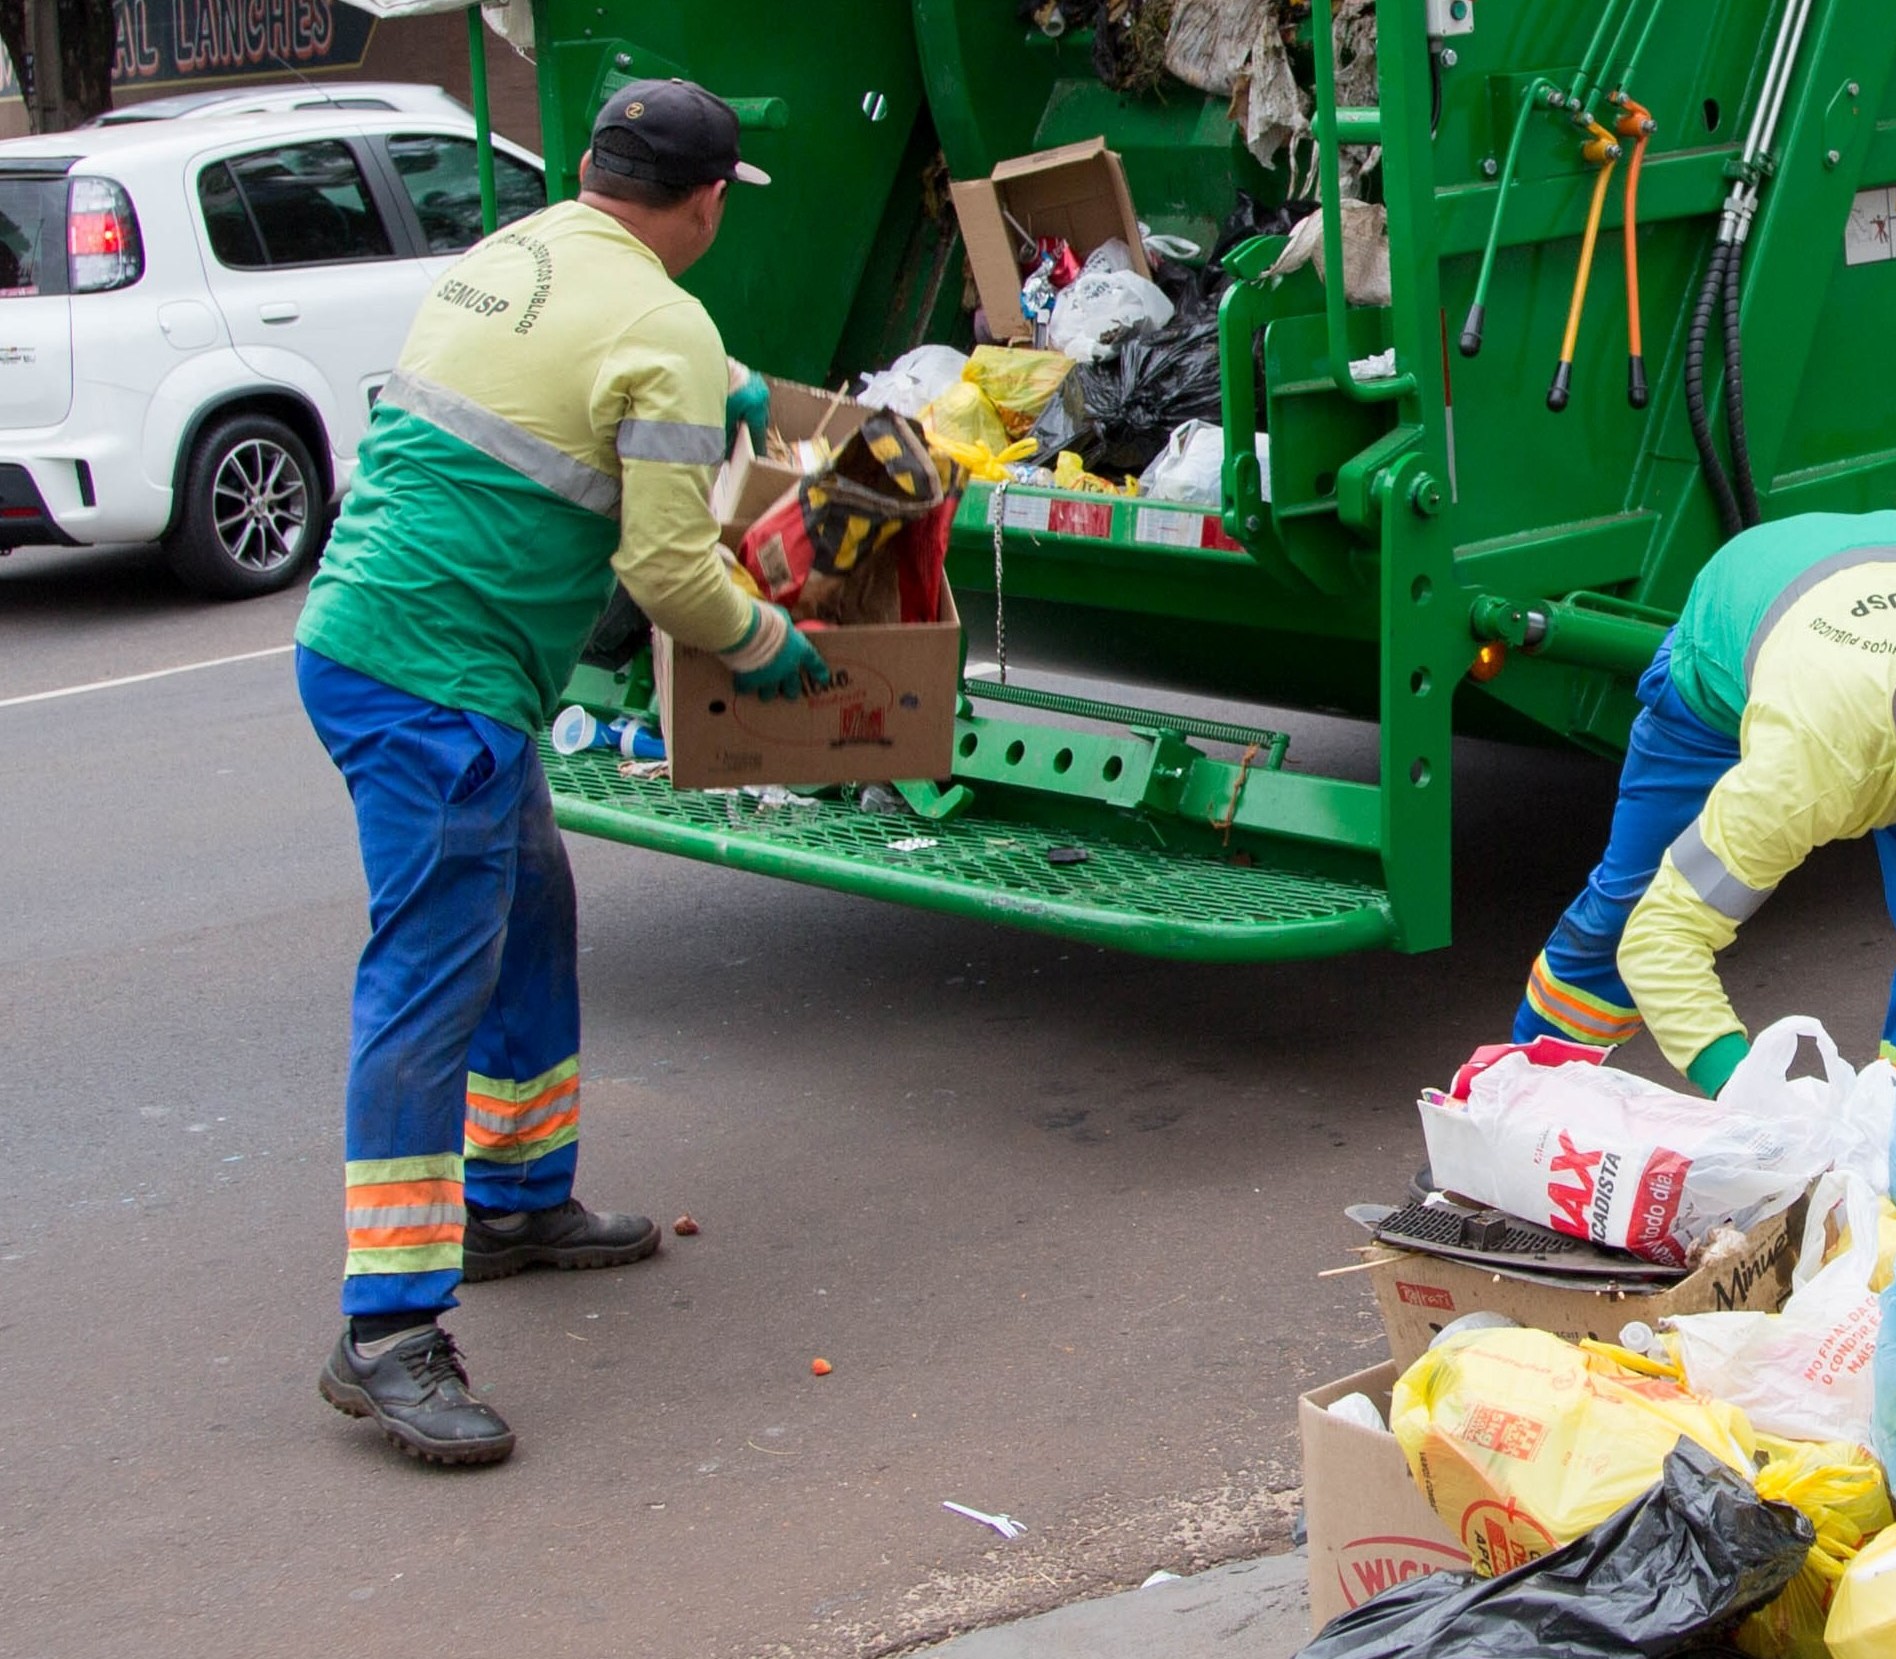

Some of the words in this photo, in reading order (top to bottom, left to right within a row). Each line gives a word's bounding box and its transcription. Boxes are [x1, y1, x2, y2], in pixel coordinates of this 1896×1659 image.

[111, 0, 158, 77] AL
[173, 0, 333, 72] LANCHES
[437, 279, 510, 317] SEMUSP
[1548, 1128, 1604, 1243] AX
[1649, 1172, 1674, 1202] dia.
[1639, 1203, 1667, 1240] todo
[1712, 1231, 1789, 1313] Minue
[1804, 1359, 1823, 1381] NO
[1818, 1324, 1852, 1360] FINAL
[1848, 1306, 1868, 1323] DA
[1821, 1374, 1833, 1386] O
[1829, 1324, 1870, 1373] CONDOR
[1847, 1342, 1876, 1375] MAIS
[1352, 1557, 1443, 1598] WIC
